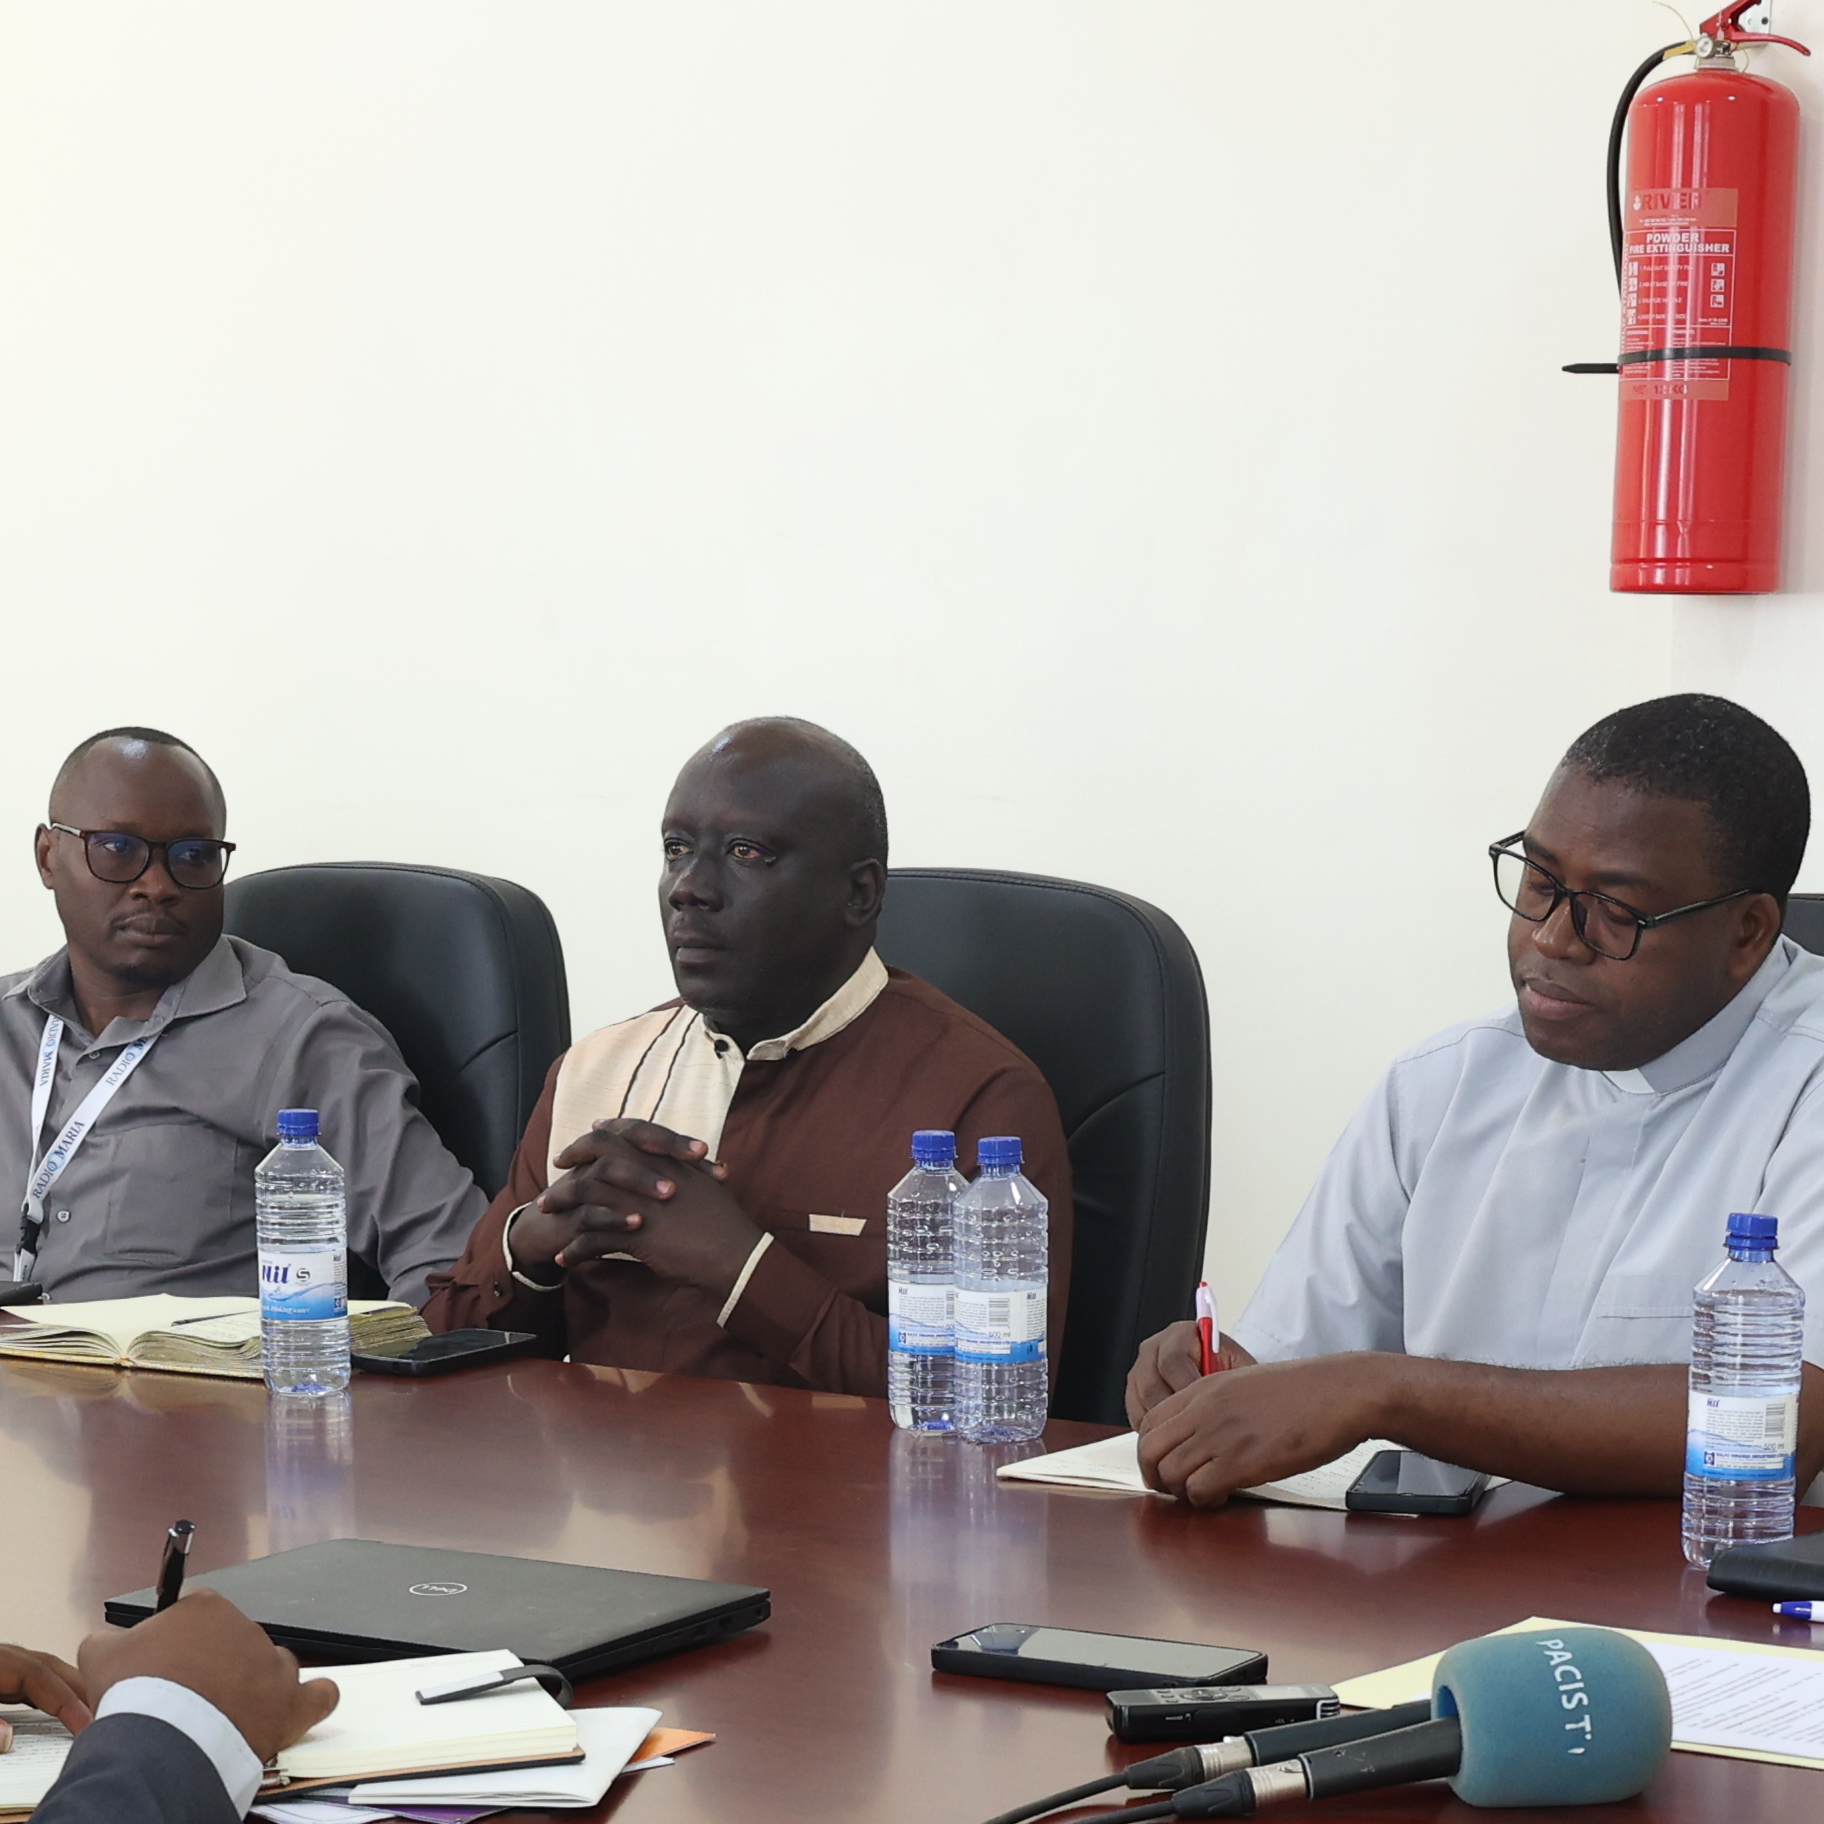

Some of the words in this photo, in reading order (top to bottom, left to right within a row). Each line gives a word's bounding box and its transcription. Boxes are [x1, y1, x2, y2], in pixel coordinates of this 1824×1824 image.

[1642, 192, 1701, 210] RIVER
[1629, 245, 1644, 253] FIRE
[1646, 244, 1729, 253] EXTINGUISHER
[1646, 233, 1699, 243] POWDER
[46, 1016, 59, 1047] RADIO
[39, 1051, 53, 1087] MARIA
[105, 1052, 136, 1086] RADIO
[32, 1161, 58, 1199] RADIO
[53, 1121, 85, 1159] MARIA
[262, 1265, 289, 1284] Nil
[1536, 1638, 1589, 1710] PACIS
